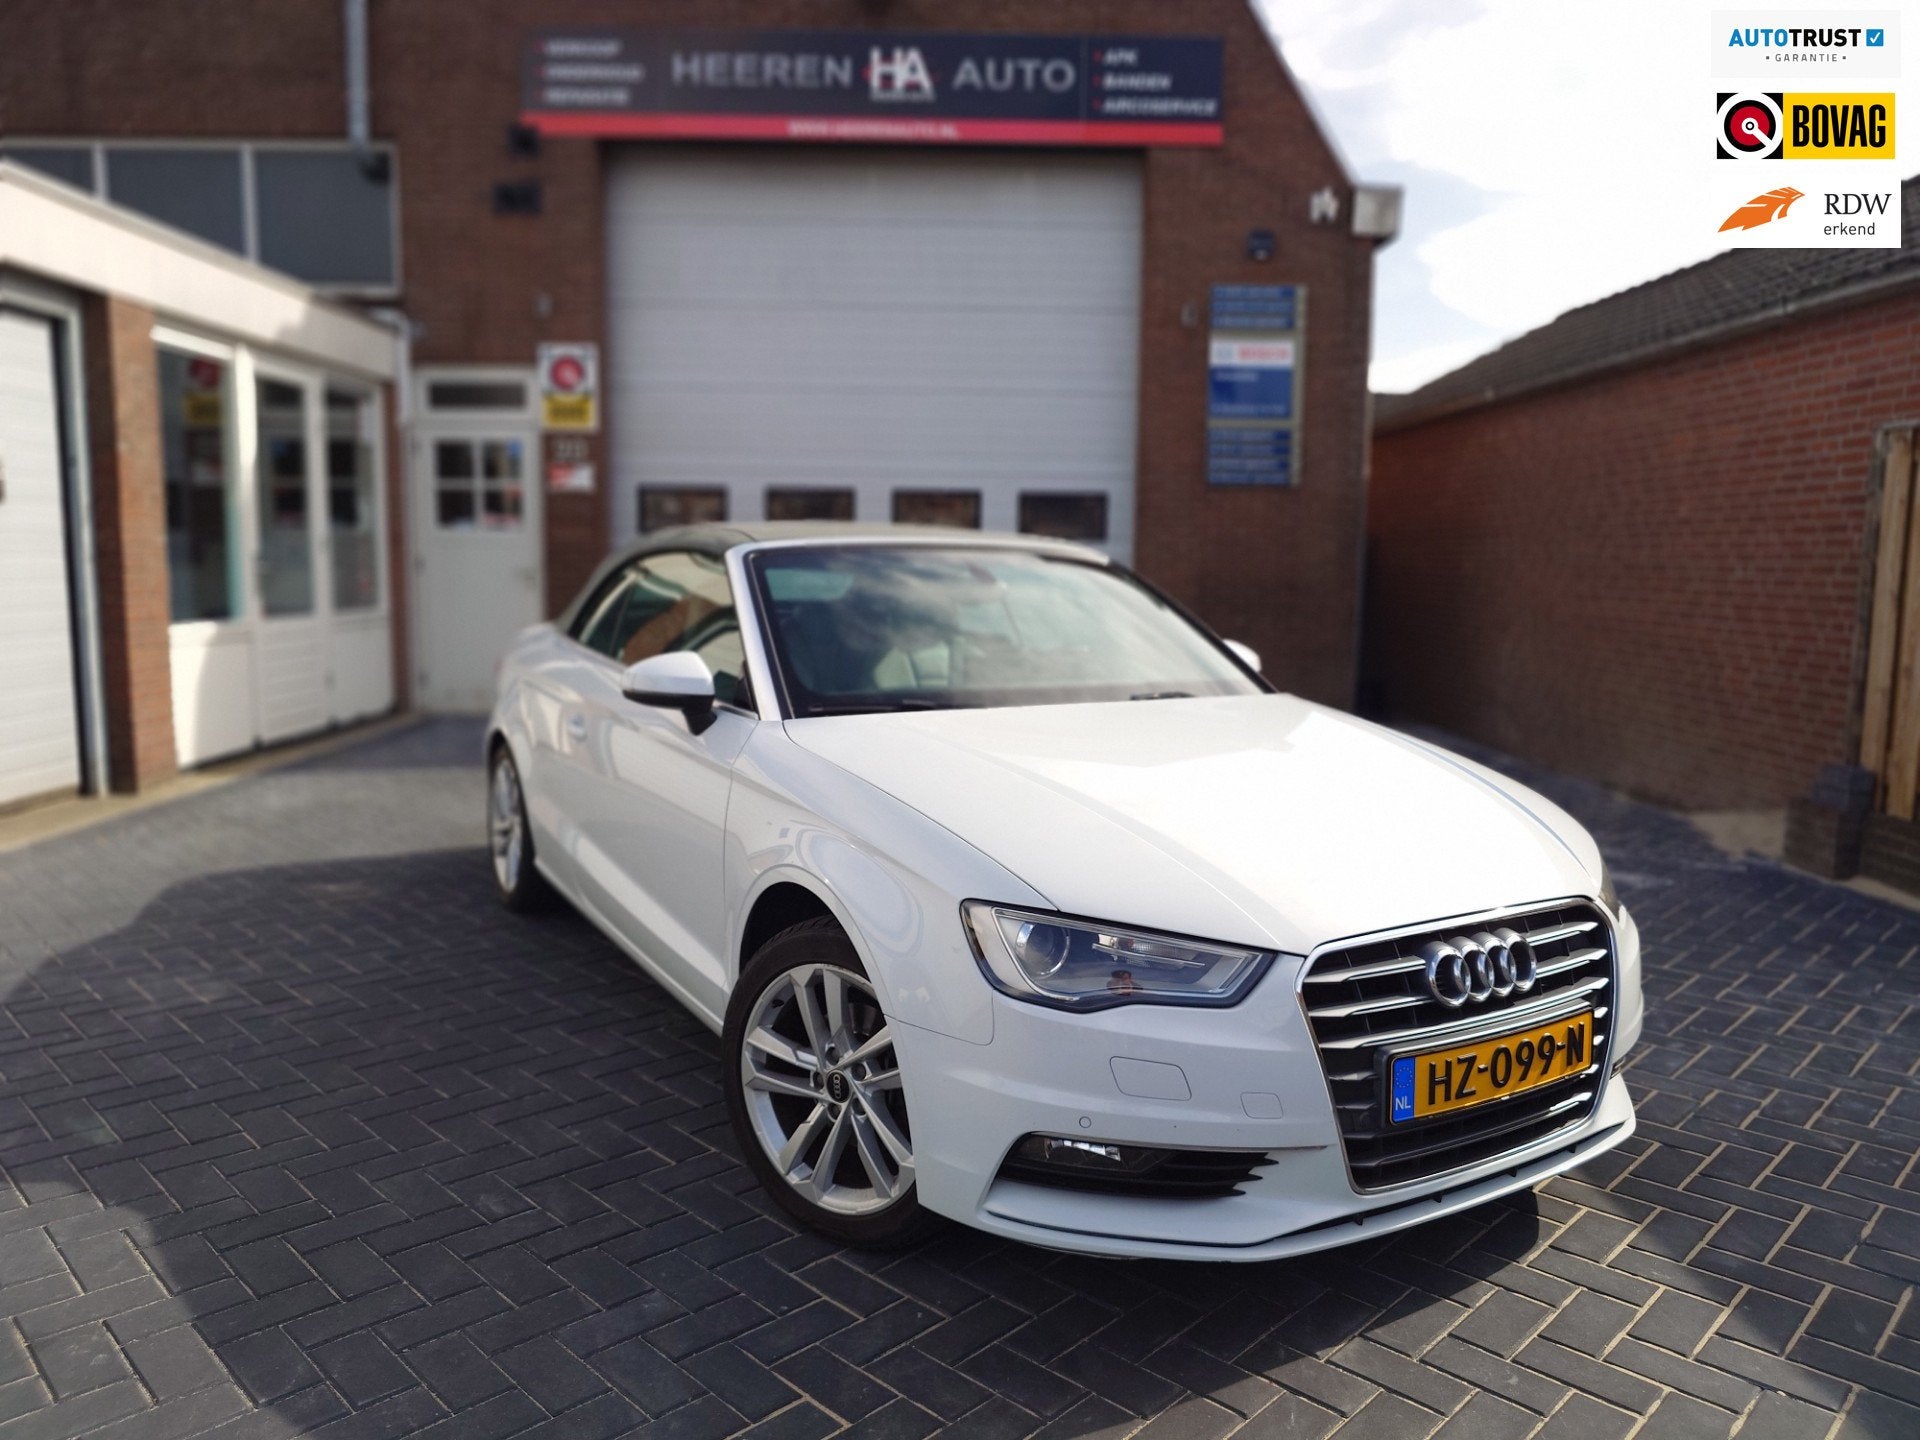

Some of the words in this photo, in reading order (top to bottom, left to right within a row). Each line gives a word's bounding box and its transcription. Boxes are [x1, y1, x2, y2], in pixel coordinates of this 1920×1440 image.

[1103, 48, 1138, 65] APK
[671, 52, 853, 89] HEEREN
[953, 57, 1077, 93] AUTO
[1102, 73, 1172, 91] BANDEN
[1395, 1097, 1411, 1110] NL
[1428, 1021, 1585, 1106] HZ-099-N
